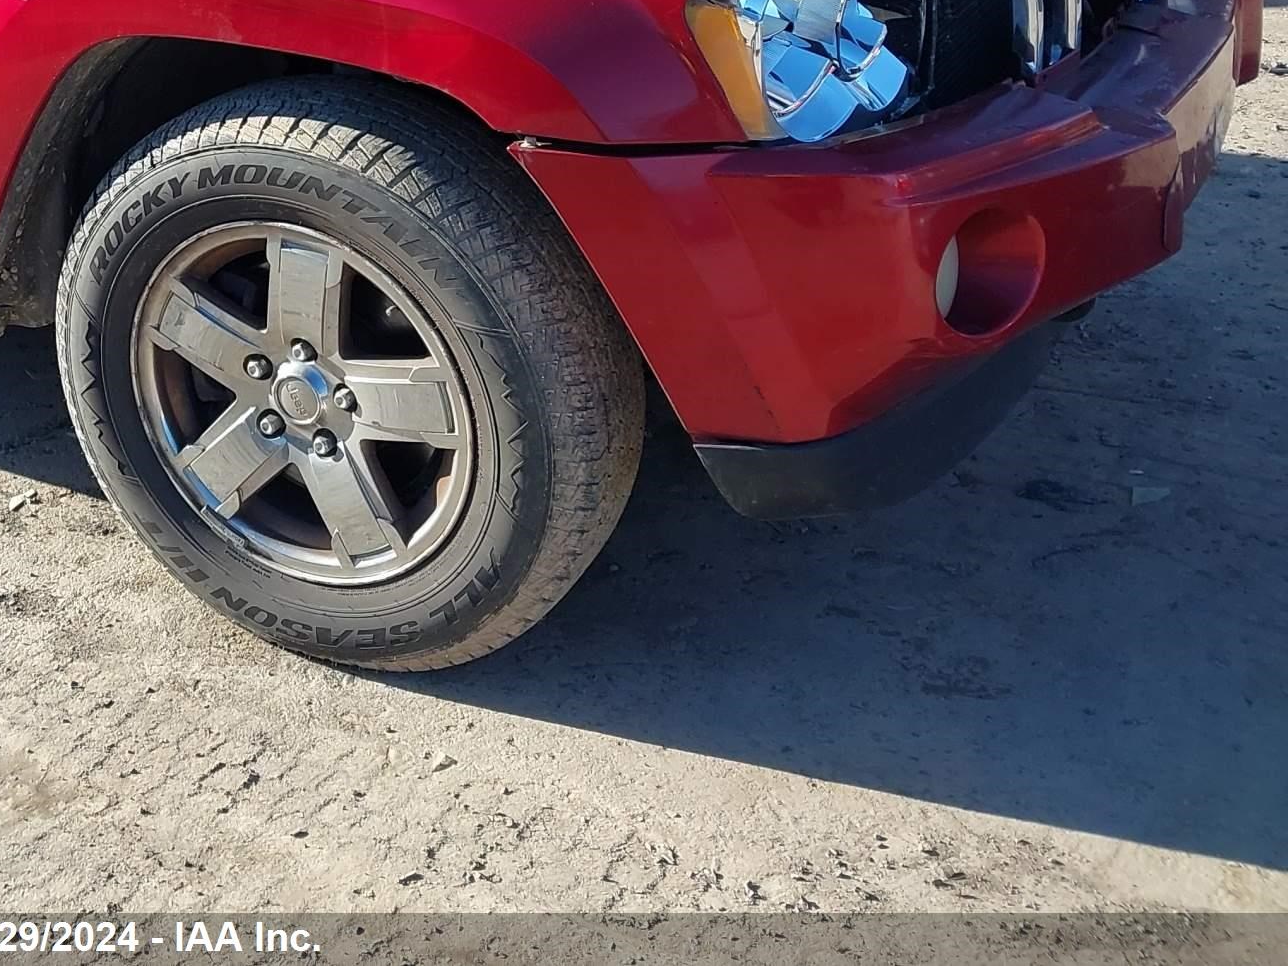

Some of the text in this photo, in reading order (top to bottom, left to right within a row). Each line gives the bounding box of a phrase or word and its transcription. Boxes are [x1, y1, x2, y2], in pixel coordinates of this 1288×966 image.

[88, 163, 464, 292] ROCKY MOUNTAIN
[210, 586, 424, 651] SEASON
[429, 546, 501, 626] ALL
